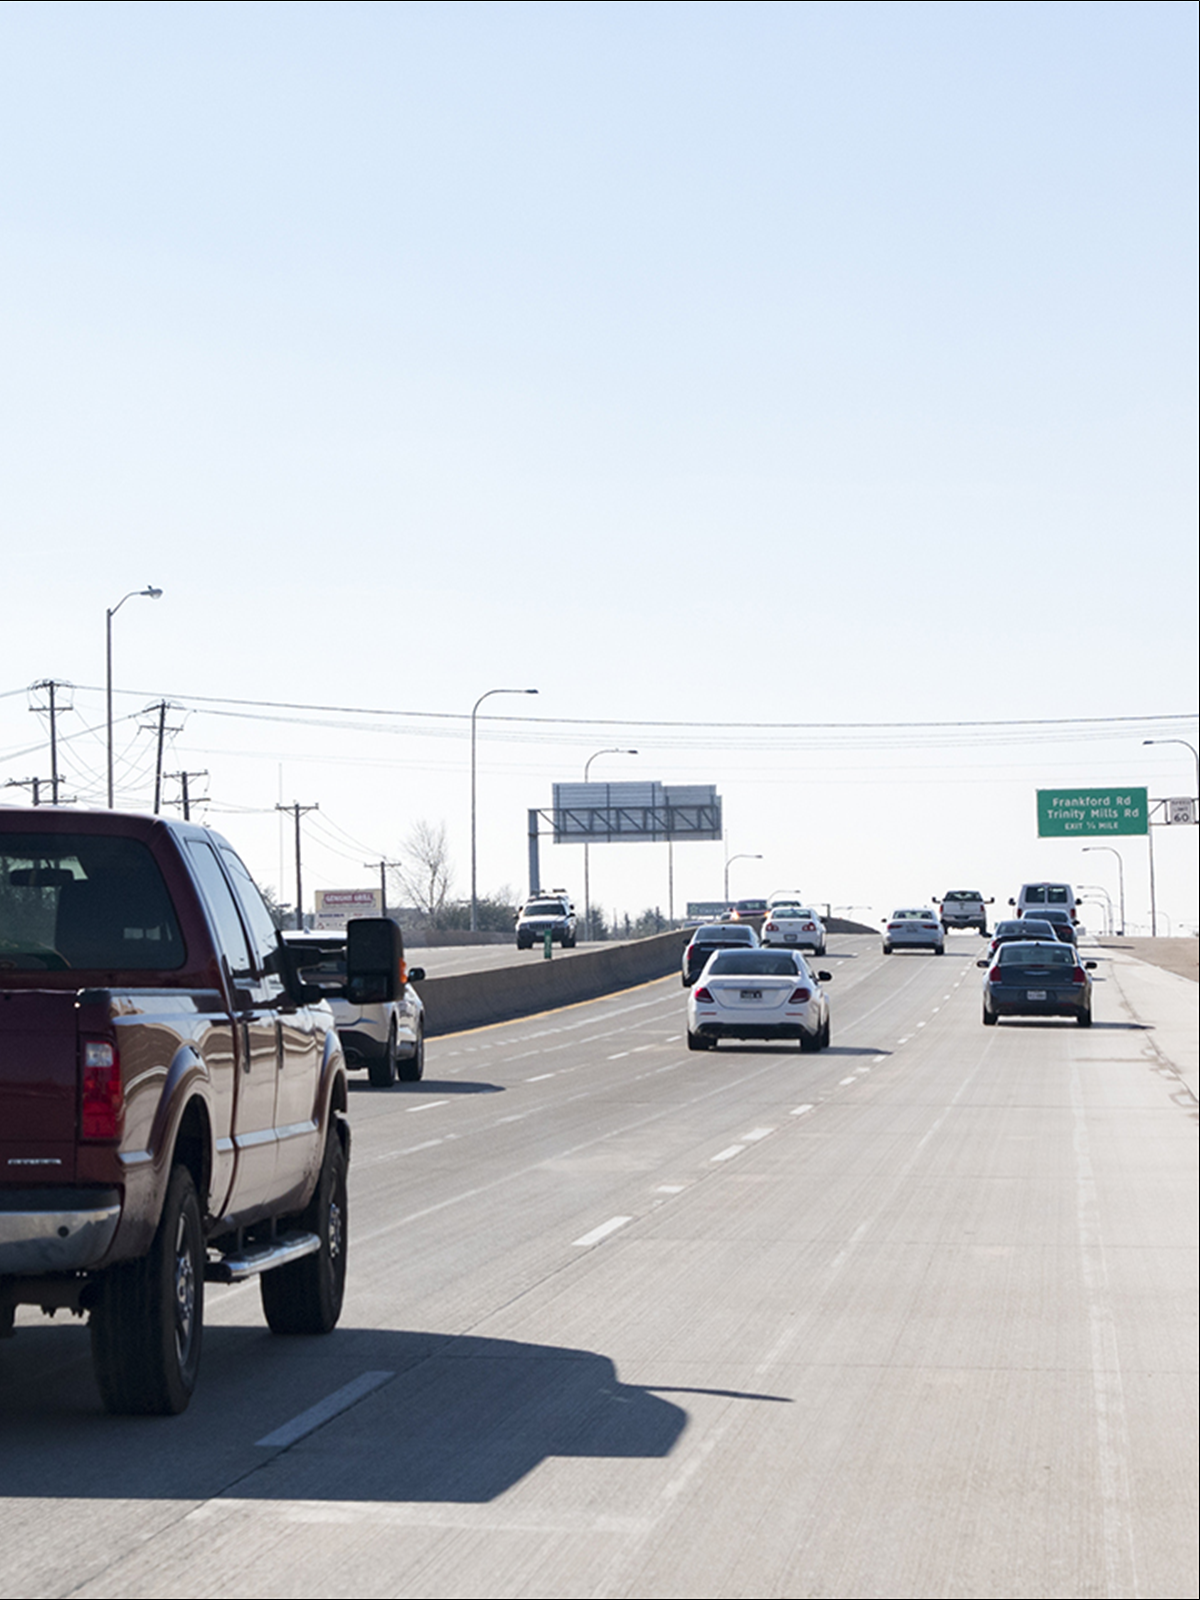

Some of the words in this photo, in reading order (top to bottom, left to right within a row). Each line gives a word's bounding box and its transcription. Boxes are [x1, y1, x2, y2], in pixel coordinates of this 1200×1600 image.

[1052, 797, 1110, 807] Frankford
[1116, 796, 1132, 806] Rd
[1047, 809, 1086, 820] Trinity
[1090, 808, 1119, 818] Mills
[1124, 808, 1140, 818] Rd
[1174, 813, 1190, 823] 60
[1064, 822, 1083, 830] EXIT
[1098, 821, 1119, 829] MILE
